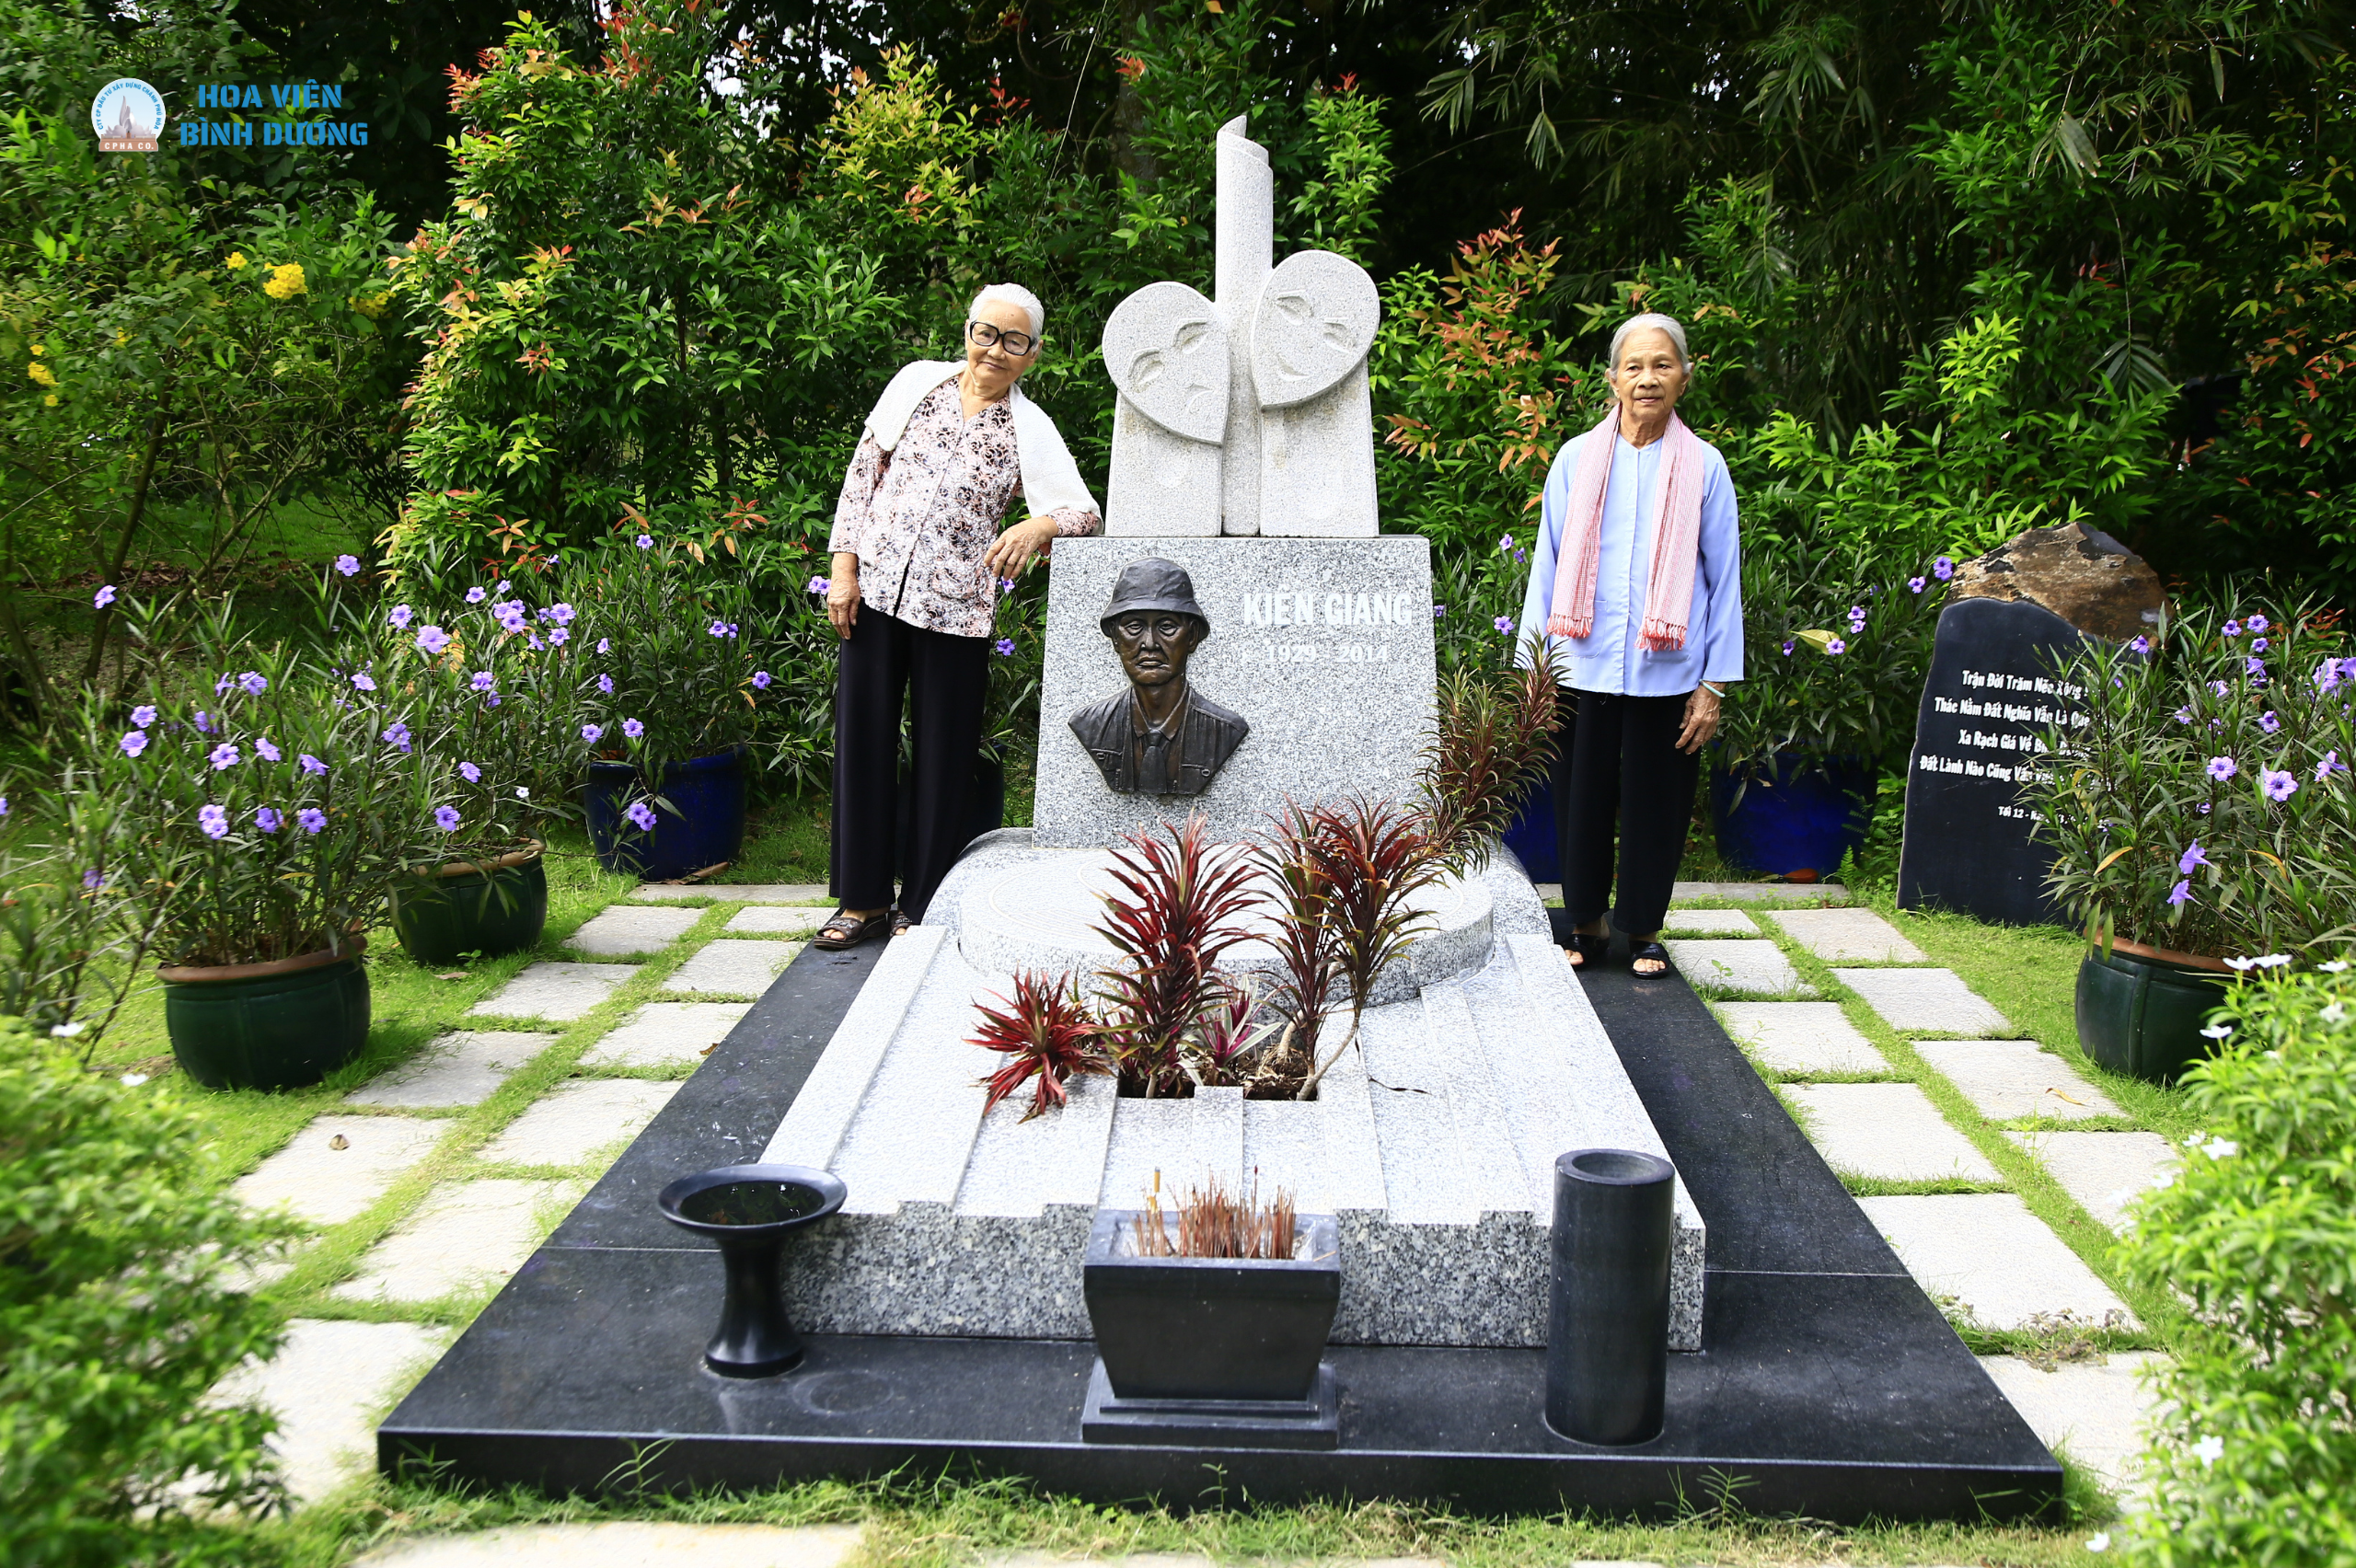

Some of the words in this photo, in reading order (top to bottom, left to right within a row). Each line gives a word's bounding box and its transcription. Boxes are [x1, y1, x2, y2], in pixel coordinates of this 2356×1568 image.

[1243, 583, 1314, 626] KIÊN
[1323, 593, 1413, 627] GIANG
[1266, 645, 1317, 663] 1929
[1335, 645, 1388, 663] 2014
[1962, 669, 1985, 689] Trận
[1986, 672, 2005, 688] Đời
[2005, 674, 2033, 691] Trăm
[1934, 697, 1958, 713] Thác
[1959, 697, 1982, 716] Nằm
[1983, 701, 2003, 718] Đất
[2003, 703, 2032, 722] Nghĩa
[2054, 709, 2068, 725] Là
[1958, 729, 1971, 745] Xa
[1972, 730, 1999, 750] Rạch
[2000, 733, 2016, 750] Giá
[1919, 755, 1938, 772] Đất
[1939, 756, 1964, 775] Lành
[1964, 759, 1985, 777] Nào
[1986, 762, 2013, 782] Cũng
[2012, 808, 2025, 819] 12
